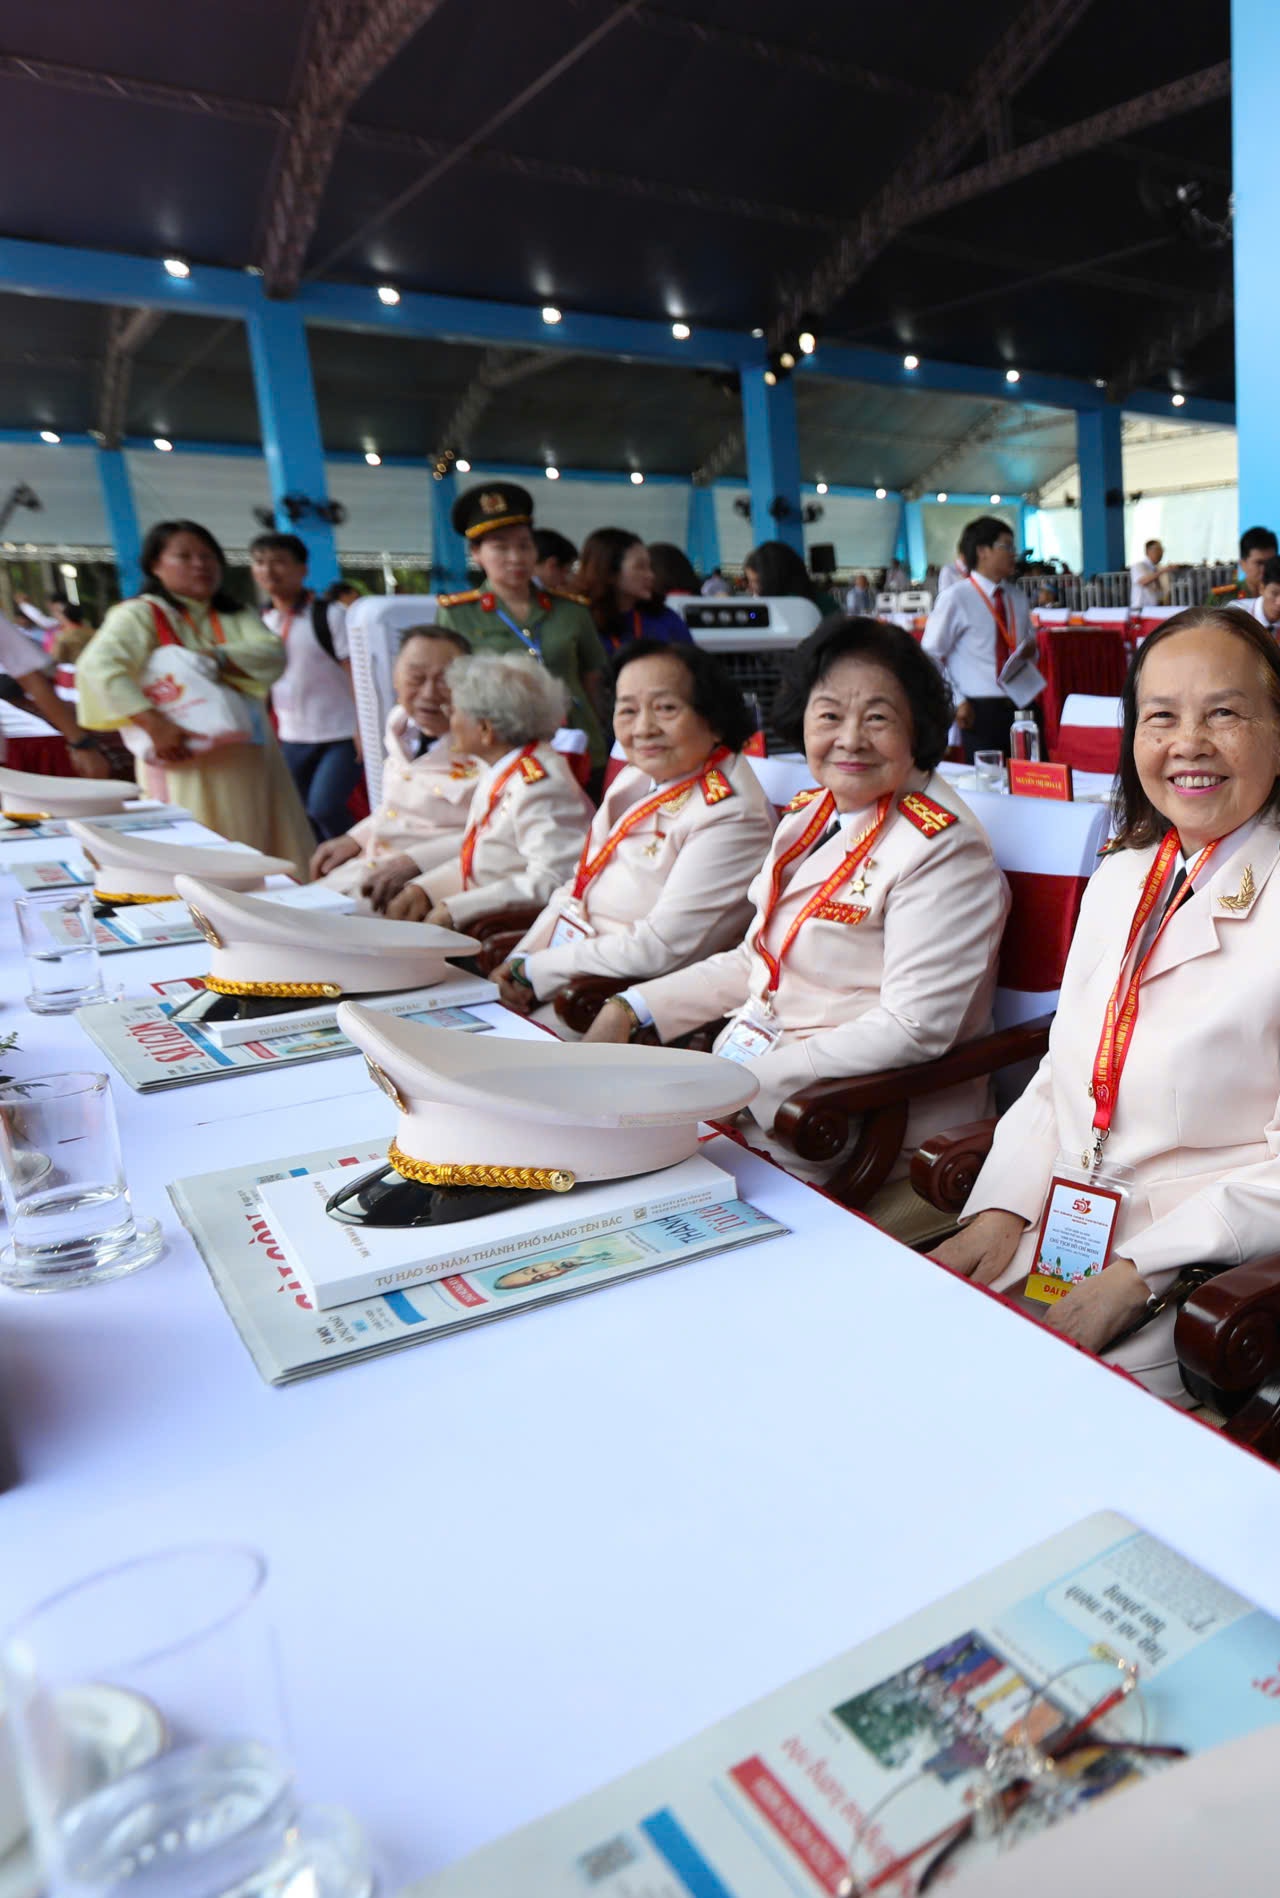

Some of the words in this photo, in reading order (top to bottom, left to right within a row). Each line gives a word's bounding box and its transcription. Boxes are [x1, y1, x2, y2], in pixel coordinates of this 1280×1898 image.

[376, 1274, 394, 1287] TỰ
[396, 1267, 424, 1283] HÀO
[441, 1255, 470, 1273] NĂM
[473, 1240, 516, 1261] THÀNH
[518, 1233, 542, 1250] PHỐ
[543, 1227, 578, 1243] MANG
[579, 1221, 600, 1235] TÊN
[601, 1214, 624, 1230] BÁC
